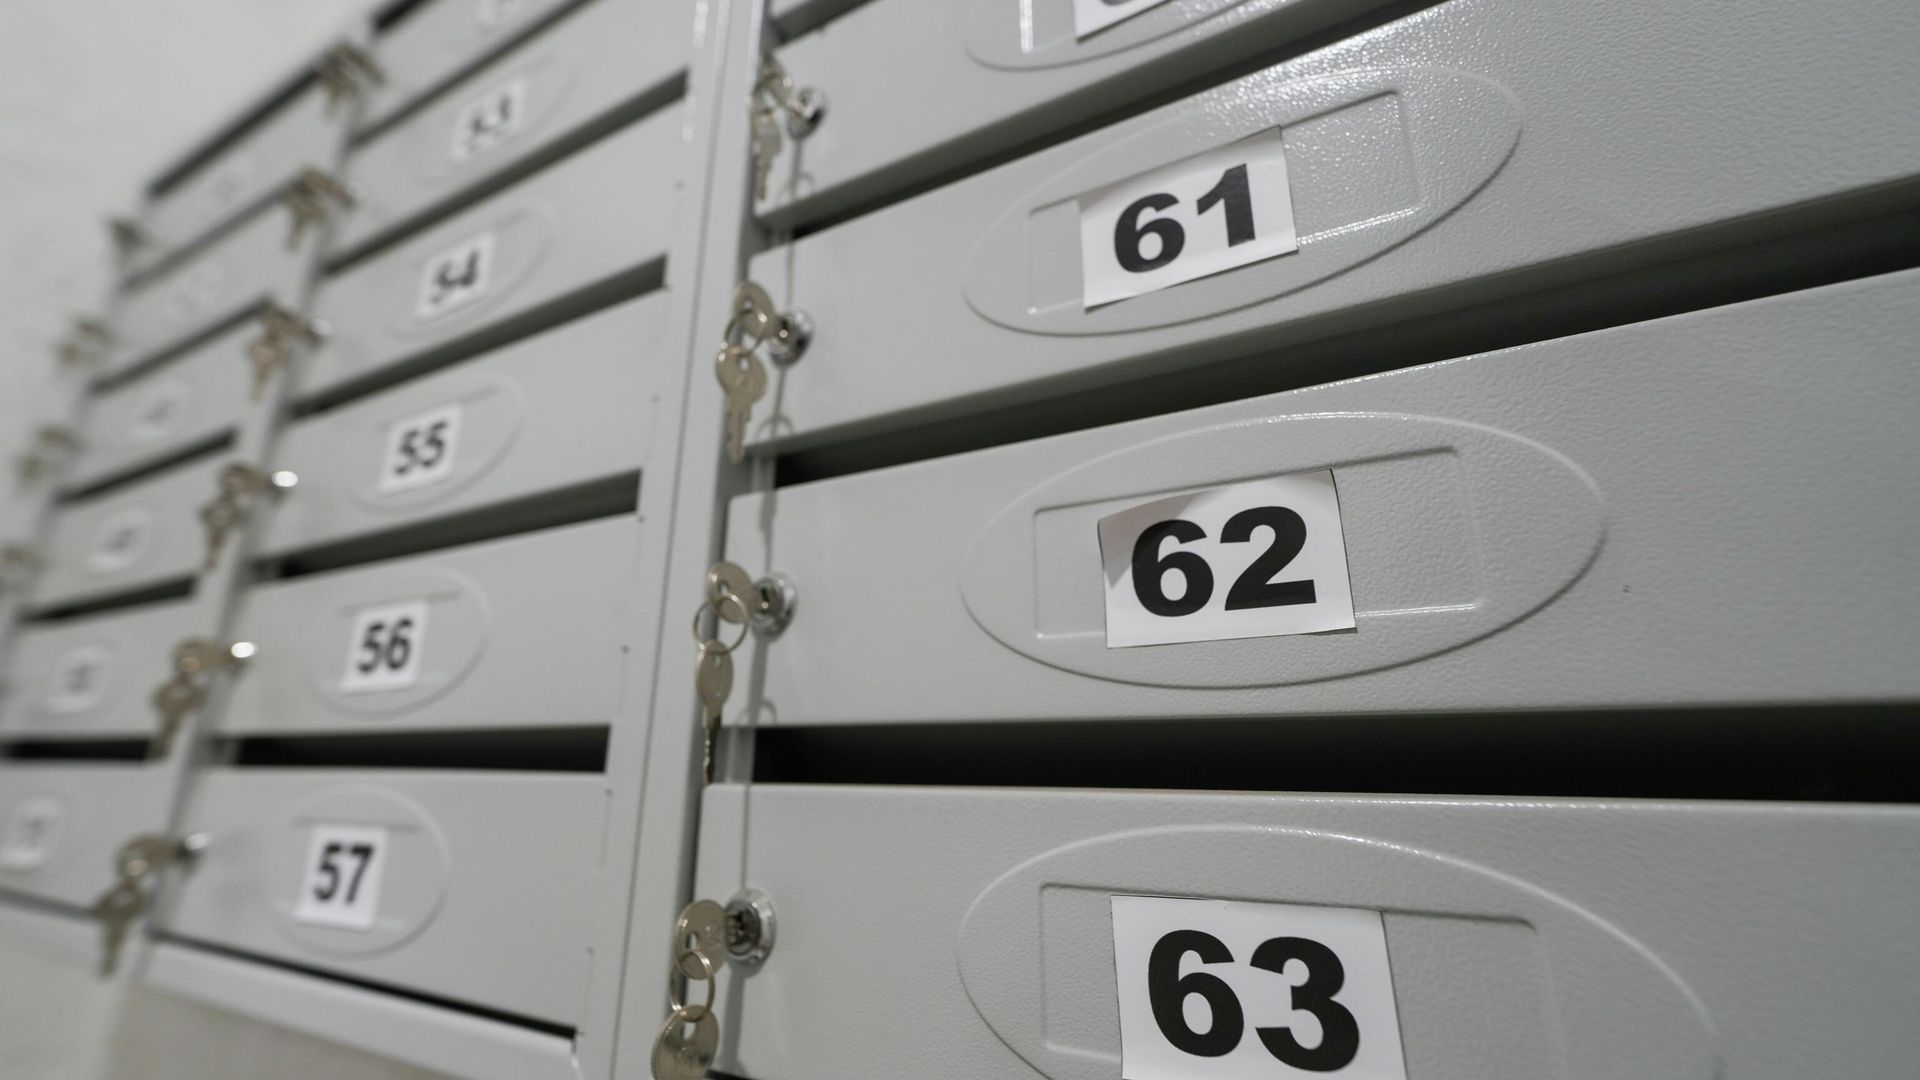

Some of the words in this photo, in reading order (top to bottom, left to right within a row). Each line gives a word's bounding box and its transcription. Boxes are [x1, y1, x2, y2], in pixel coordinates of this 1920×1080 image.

[1114, 163, 1256, 273] 61
[394, 421, 448, 475] 55
[1131, 505, 1317, 617] 62
[357, 618, 413, 673] 56
[313, 843, 376, 904] 57
[1148, 929, 1360, 1073] 63
